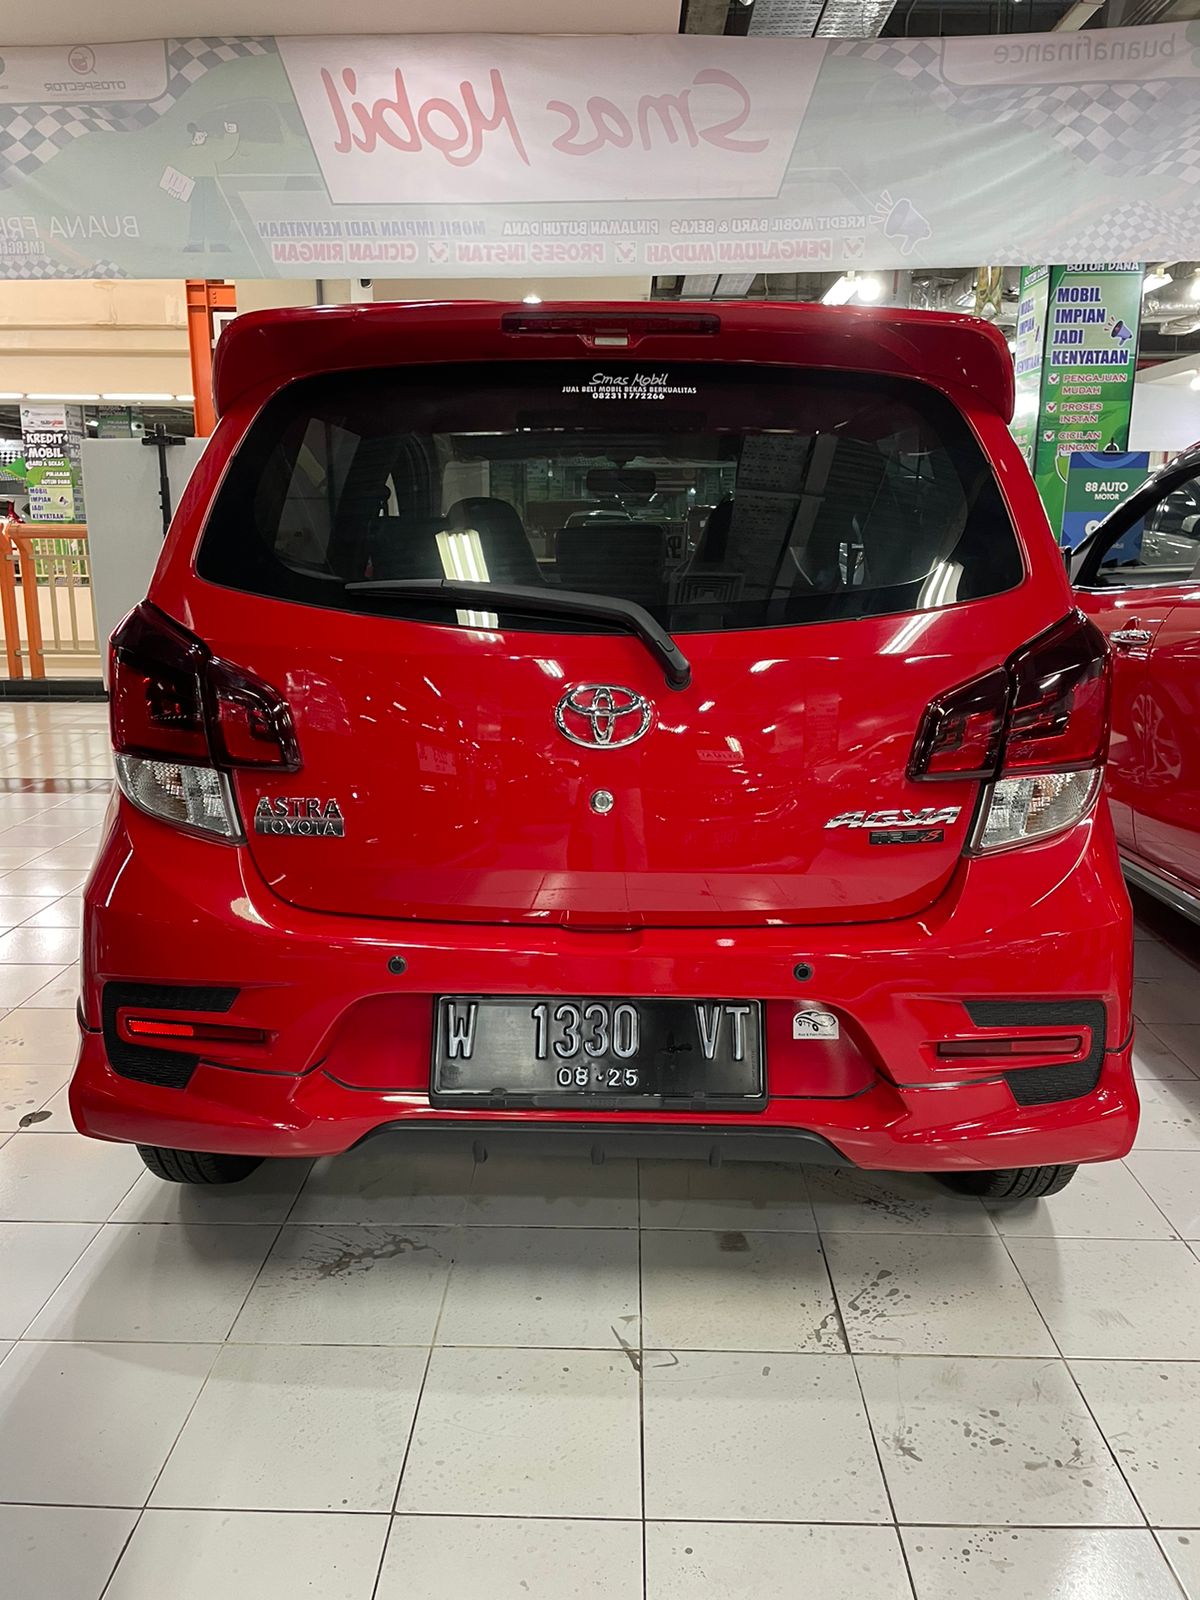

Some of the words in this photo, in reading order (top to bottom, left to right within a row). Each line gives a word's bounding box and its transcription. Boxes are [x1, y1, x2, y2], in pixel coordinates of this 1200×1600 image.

[1056, 286, 1102, 303] MOBIL
[1055, 308, 1107, 324] IMPIAN
[1052, 329, 1084, 345] JADI
[1051, 349, 1129, 365] KENYATAAN
[588, 373, 630, 386] Smas
[631, 373, 669, 387] Mobil
[1063, 374, 1127, 382] PENGAJUAN
[1062, 386, 1102, 395] MUDAH
[1061, 402, 1103, 412] PROSES
[1060, 415, 1098, 423] INSTAN
[26, 433, 63, 444] KREDIT
[1058, 431, 1102, 440] CICILAN
[28, 447, 64, 458] MOBIL
[1057, 443, 1098, 452] RINGAN
[1085, 481, 1098, 492] 88
[1098, 481, 1129, 492] AUTO
[255, 797, 343, 819] ASTRA
[824, 806, 962, 828] AGYA
[259, 818, 337, 835] TOYOTA
[447, 1003, 479, 1059] W
[531, 1003, 641, 1059] 1330
[696, 1005, 750, 1060] VT
